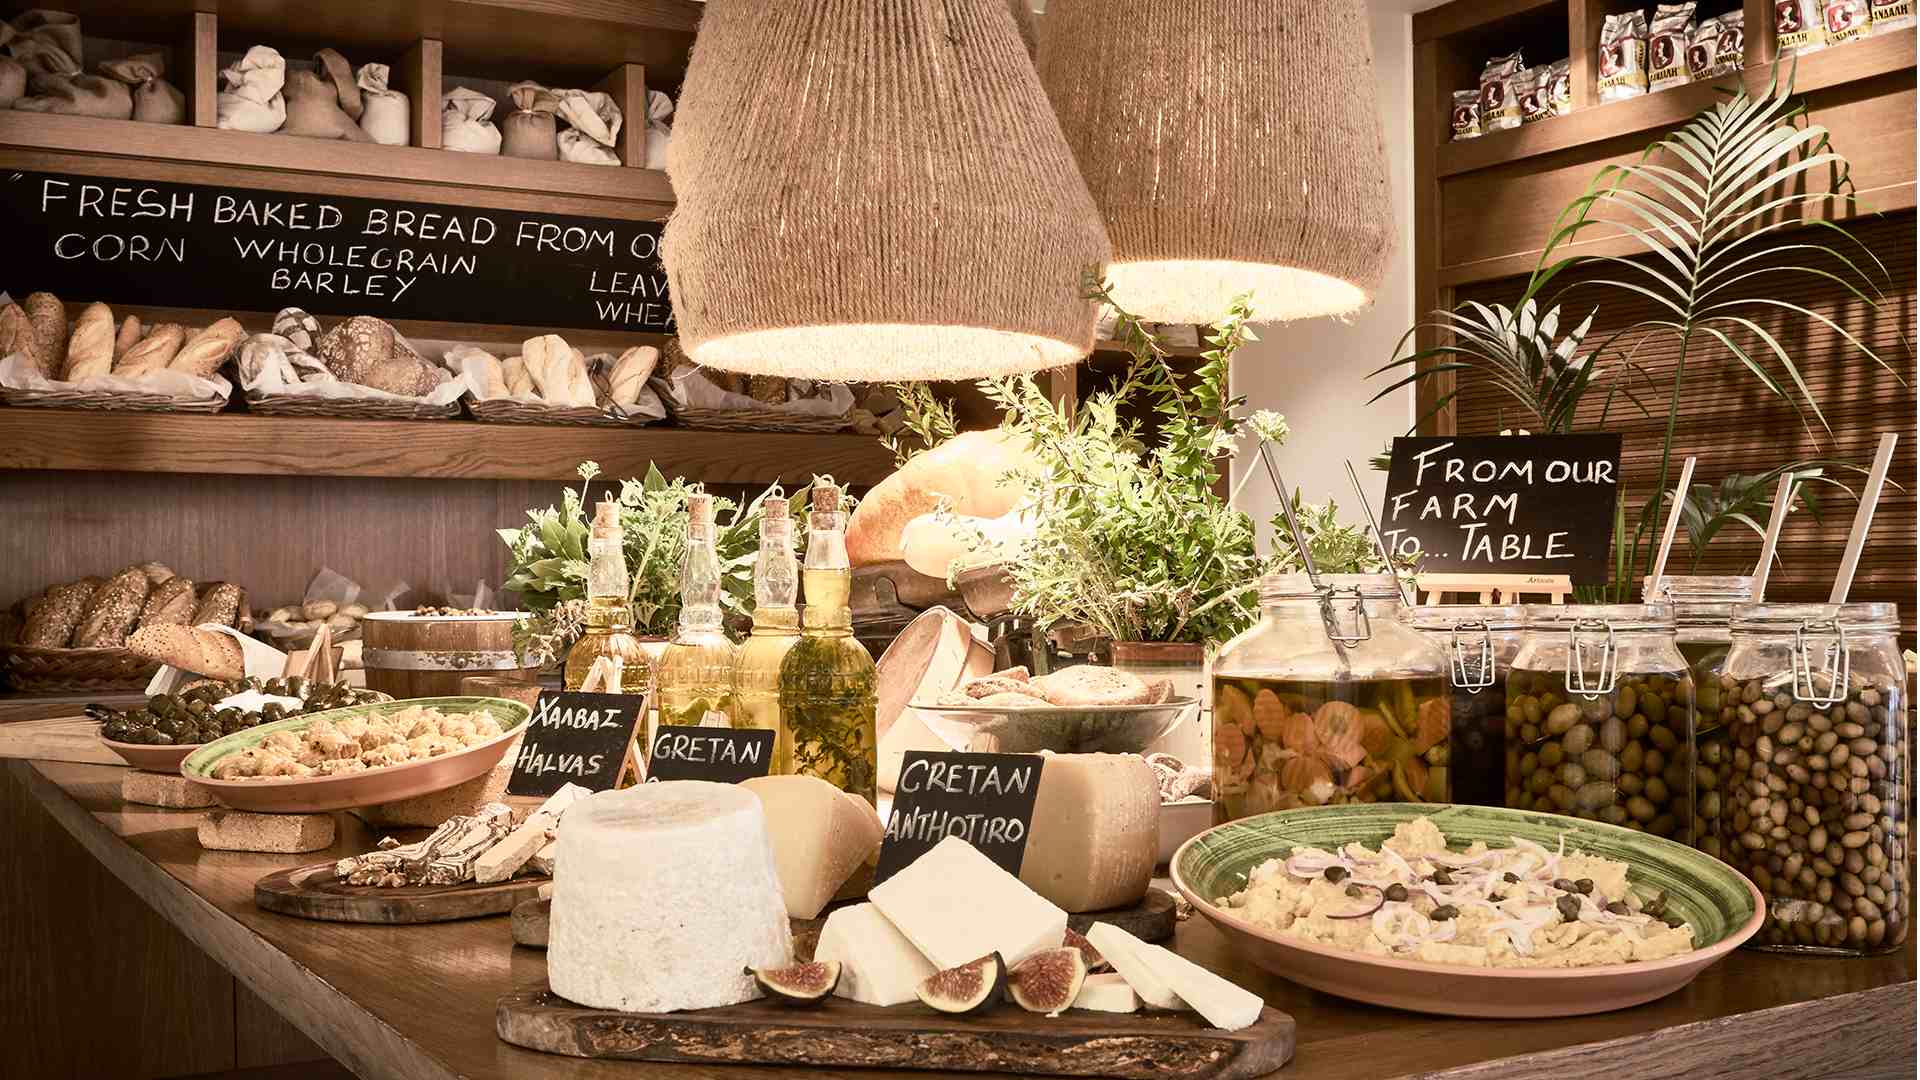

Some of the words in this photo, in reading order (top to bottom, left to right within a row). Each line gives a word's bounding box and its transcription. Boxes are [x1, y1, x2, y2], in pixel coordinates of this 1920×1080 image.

[42, 179, 194, 222] FRESH
[213, 195, 343, 229] BAKED
[362, 208, 496, 245] BREAD
[516, 221, 615, 257] FROM
[54, 233, 185, 262] CORN
[233, 236, 477, 276] WHOLEGRAIN
[271, 268, 416, 302] BARLEY
[1413, 442, 1533, 486] FROM
[1545, 459, 1616, 484] OUR
[1392, 489, 1518, 525] FARM
[1459, 522, 1575, 562] TABLE
[518, 742, 604, 777] HALVAS
[653, 731, 761, 765] GRETAN
[900, 759, 1032, 795] CRETAN
[884, 805, 1025, 844] ANTHOTIRO
